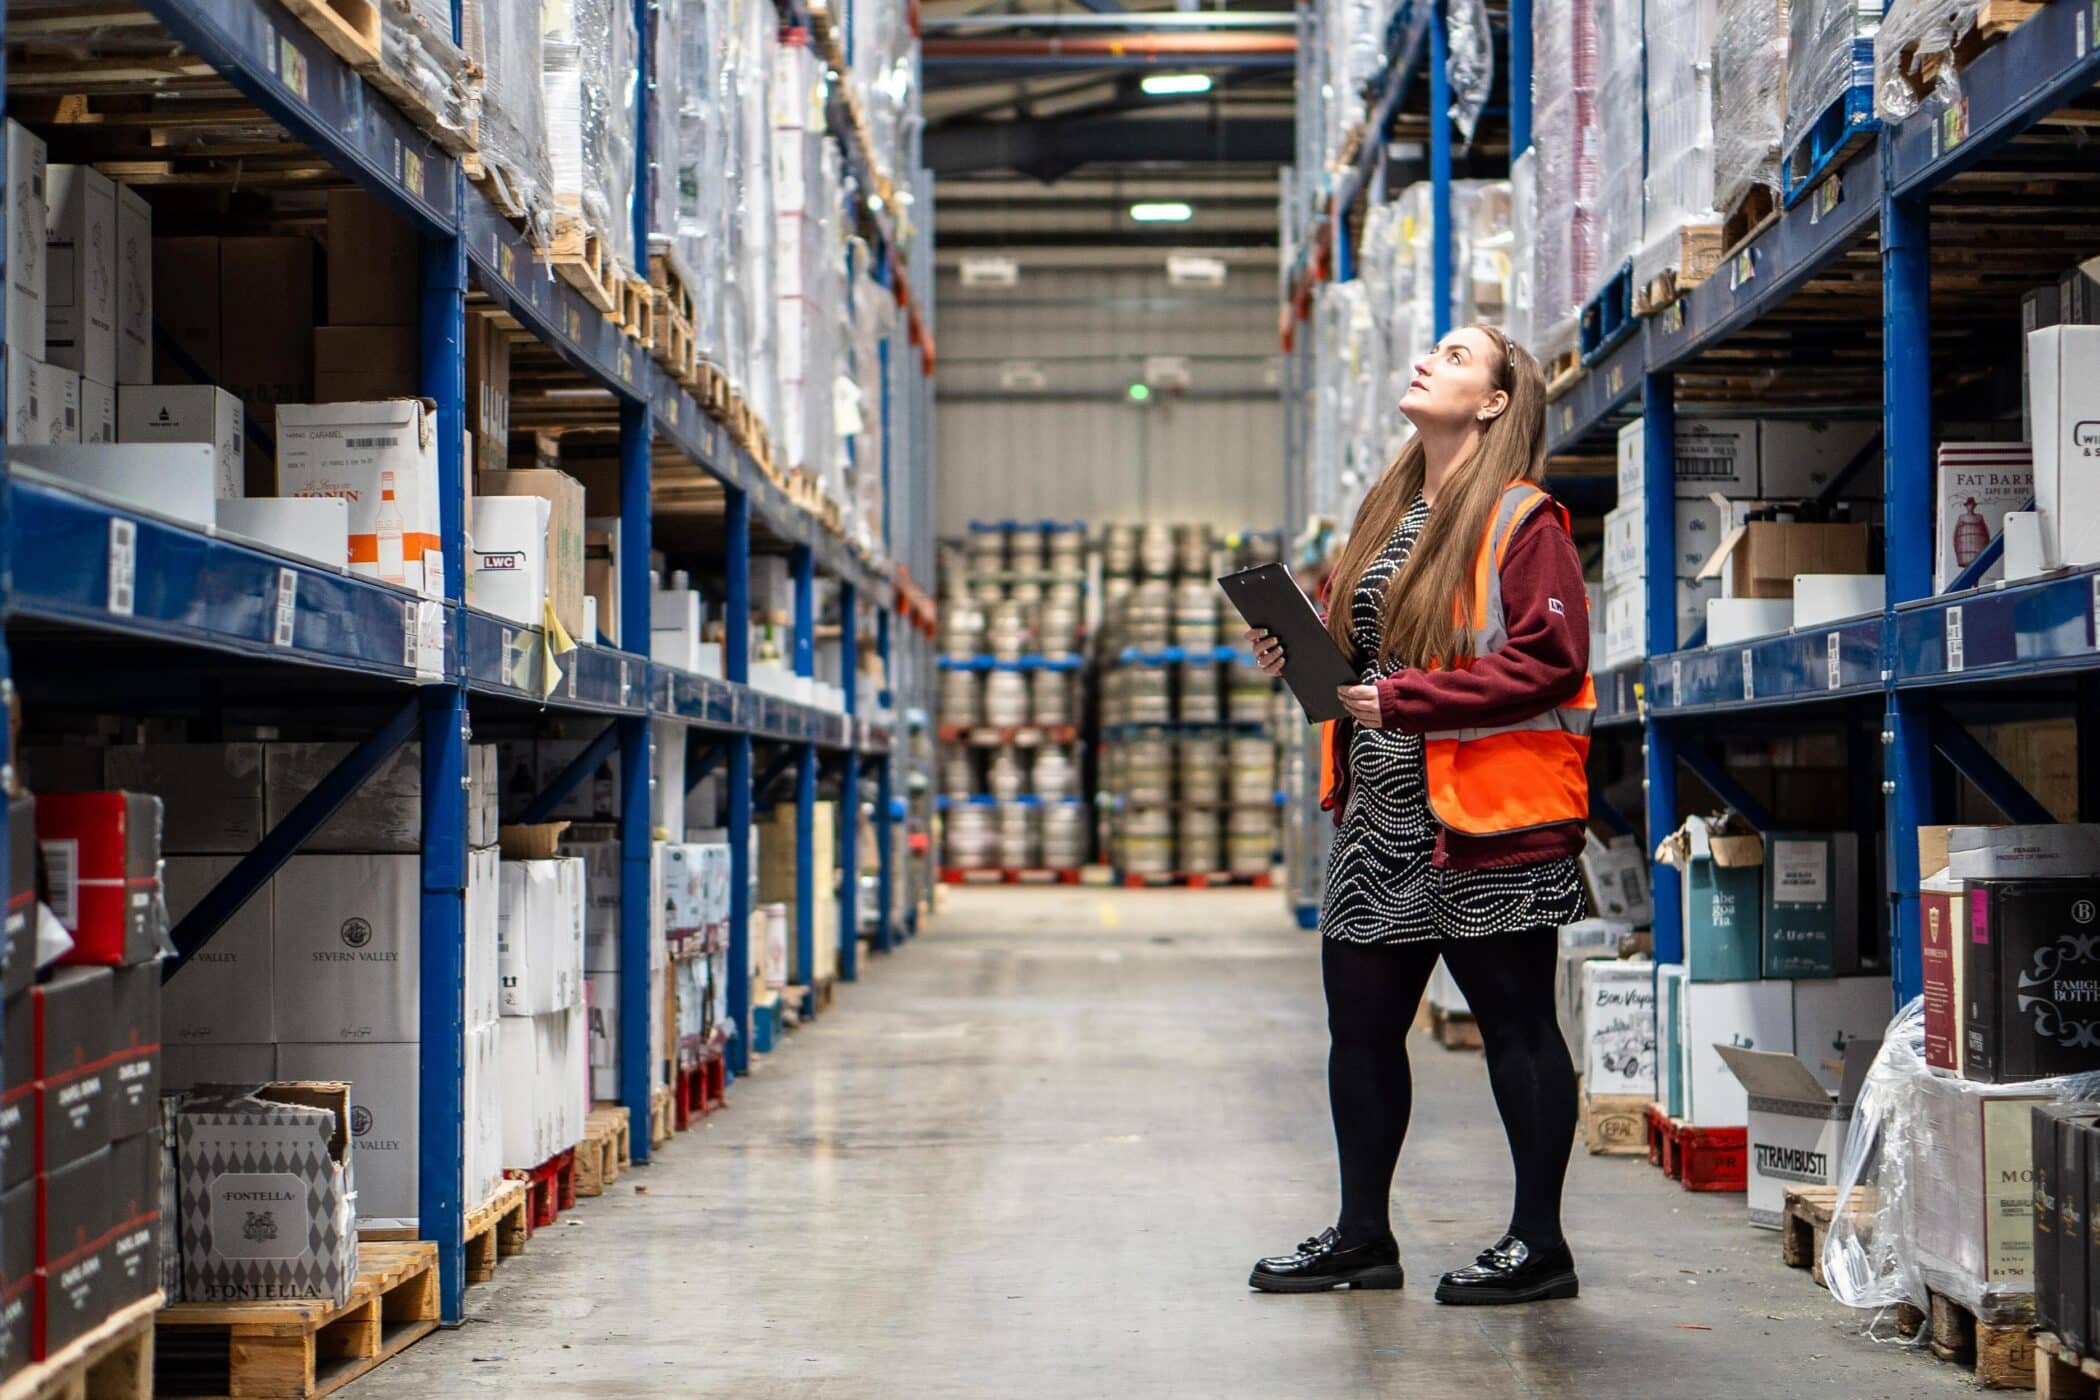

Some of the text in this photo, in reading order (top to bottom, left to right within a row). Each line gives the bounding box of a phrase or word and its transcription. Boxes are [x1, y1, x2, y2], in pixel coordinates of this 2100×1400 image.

[310, 431, 343, 440] CARAMEL
[1957, 474, 1985, 486] FAT
[486, 557, 514, 568] LWC
[1712, 891, 1735, 904] abe
[1712, 903, 1736, 918] goa
[312, 952, 399, 962] SEVERN VALLEY
[1604, 1121, 1633, 1137] EPAL
[359, 1140, 400, 1151] VALLEY
[1755, 1143, 1828, 1178] TRAMBUSTI
[225, 1191, 293, 1201] FONTELLA
[208, 1284, 318, 1298] FONTELLA
